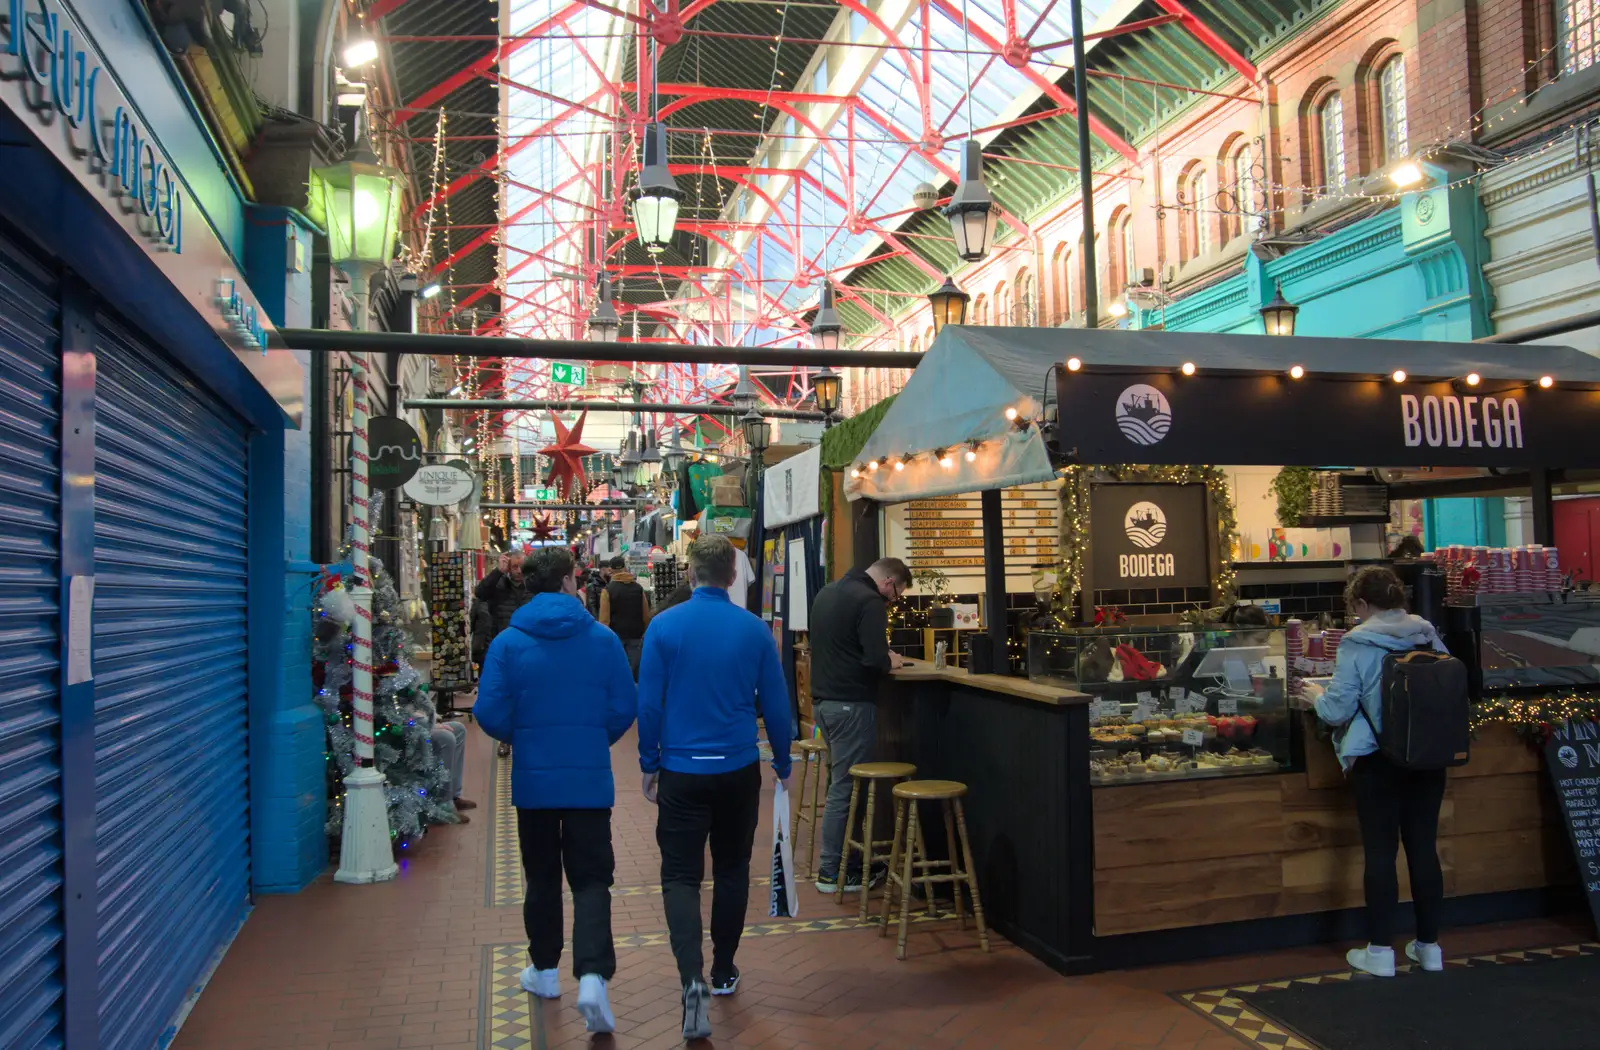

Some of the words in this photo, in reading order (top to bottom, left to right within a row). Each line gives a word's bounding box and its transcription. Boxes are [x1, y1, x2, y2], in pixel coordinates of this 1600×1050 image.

[1401, 395, 1523, 448] BODEGA
[419, 471, 458, 481] UNIQUE
[1120, 553, 1174, 577] BODEGA
[1560, 778, 1573, 787] HOT
[1563, 788, 1584, 797] WHITE
[1572, 819, 1587, 828] CHAI
[1574, 829, 1593, 838] KIDS
